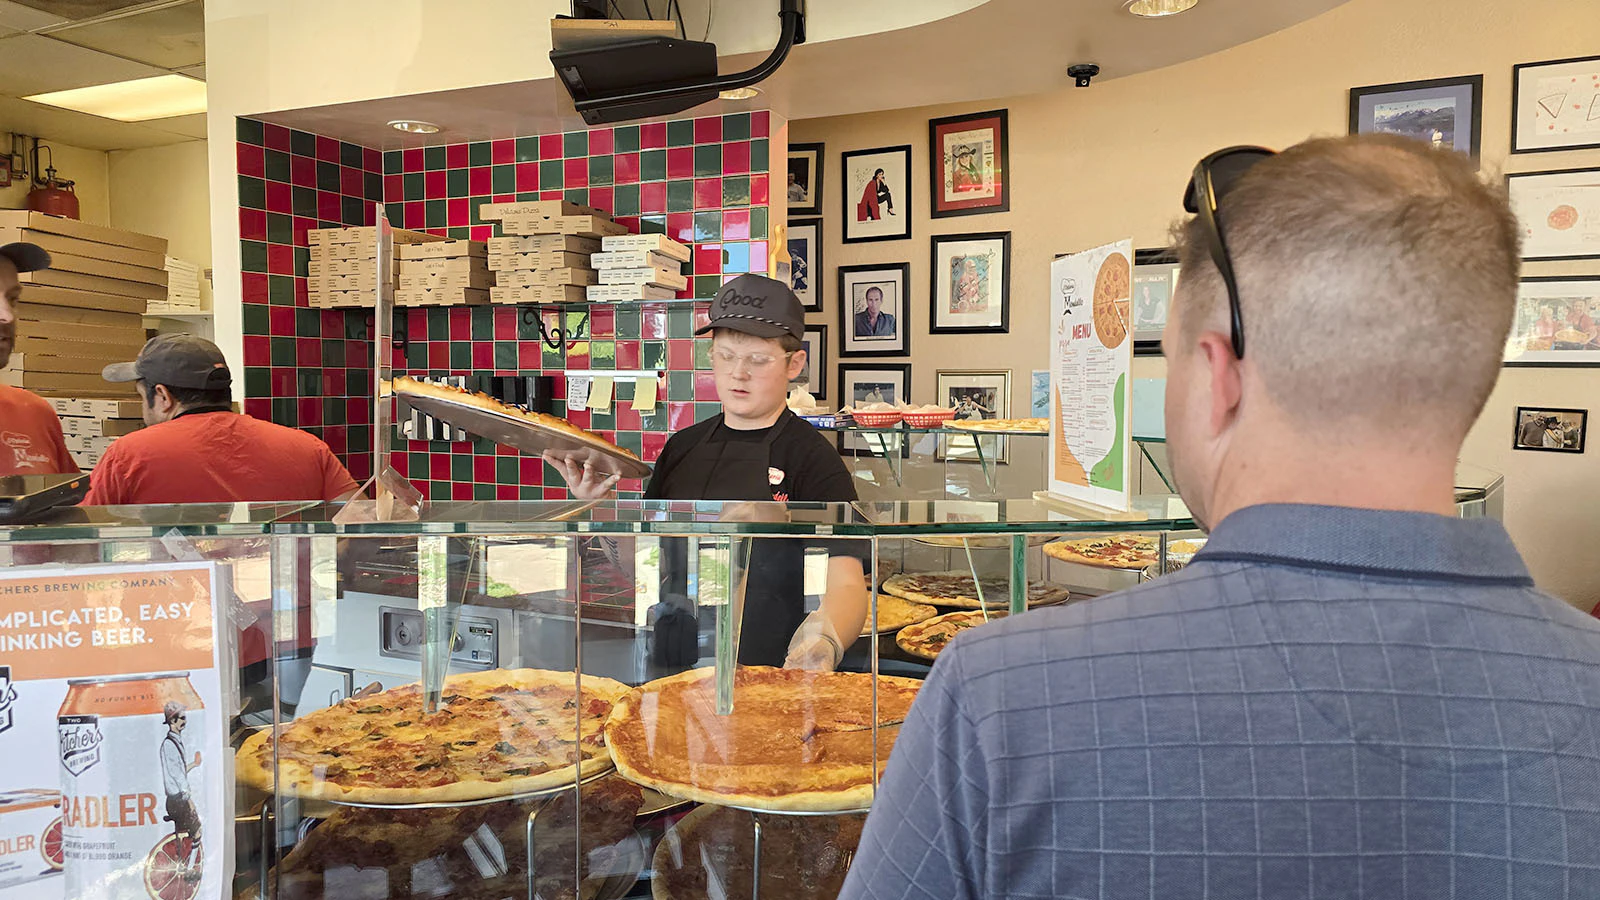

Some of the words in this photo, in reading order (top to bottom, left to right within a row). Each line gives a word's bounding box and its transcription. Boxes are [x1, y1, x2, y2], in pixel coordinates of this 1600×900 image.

[720, 288, 768, 311] Good
[1072, 323, 1092, 340] MENU
[44, 580, 105, 593] BREWING
[140, 601, 195, 622] EASY
[0, 631, 82, 652] INKING
[92, 627, 154, 647] BEER.
[62, 792, 158, 828] RADLER
